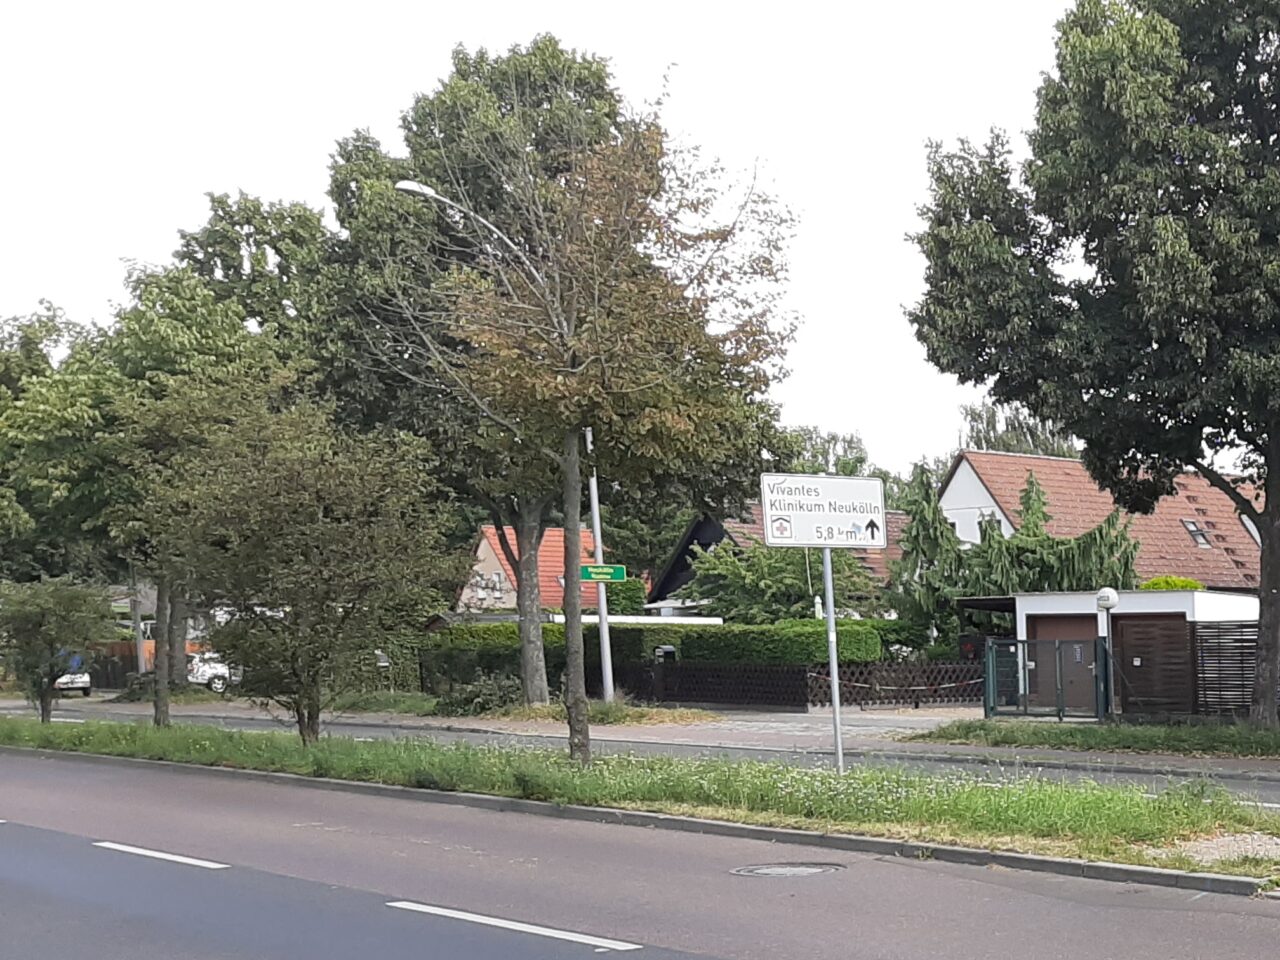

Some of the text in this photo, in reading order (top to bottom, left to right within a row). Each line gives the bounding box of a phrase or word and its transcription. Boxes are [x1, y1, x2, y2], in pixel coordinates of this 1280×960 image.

[767, 483, 820, 497] Vivantes
[769, 499, 880, 514] Klinikum Neukölln
[816, 526, 834, 541] 5,8
